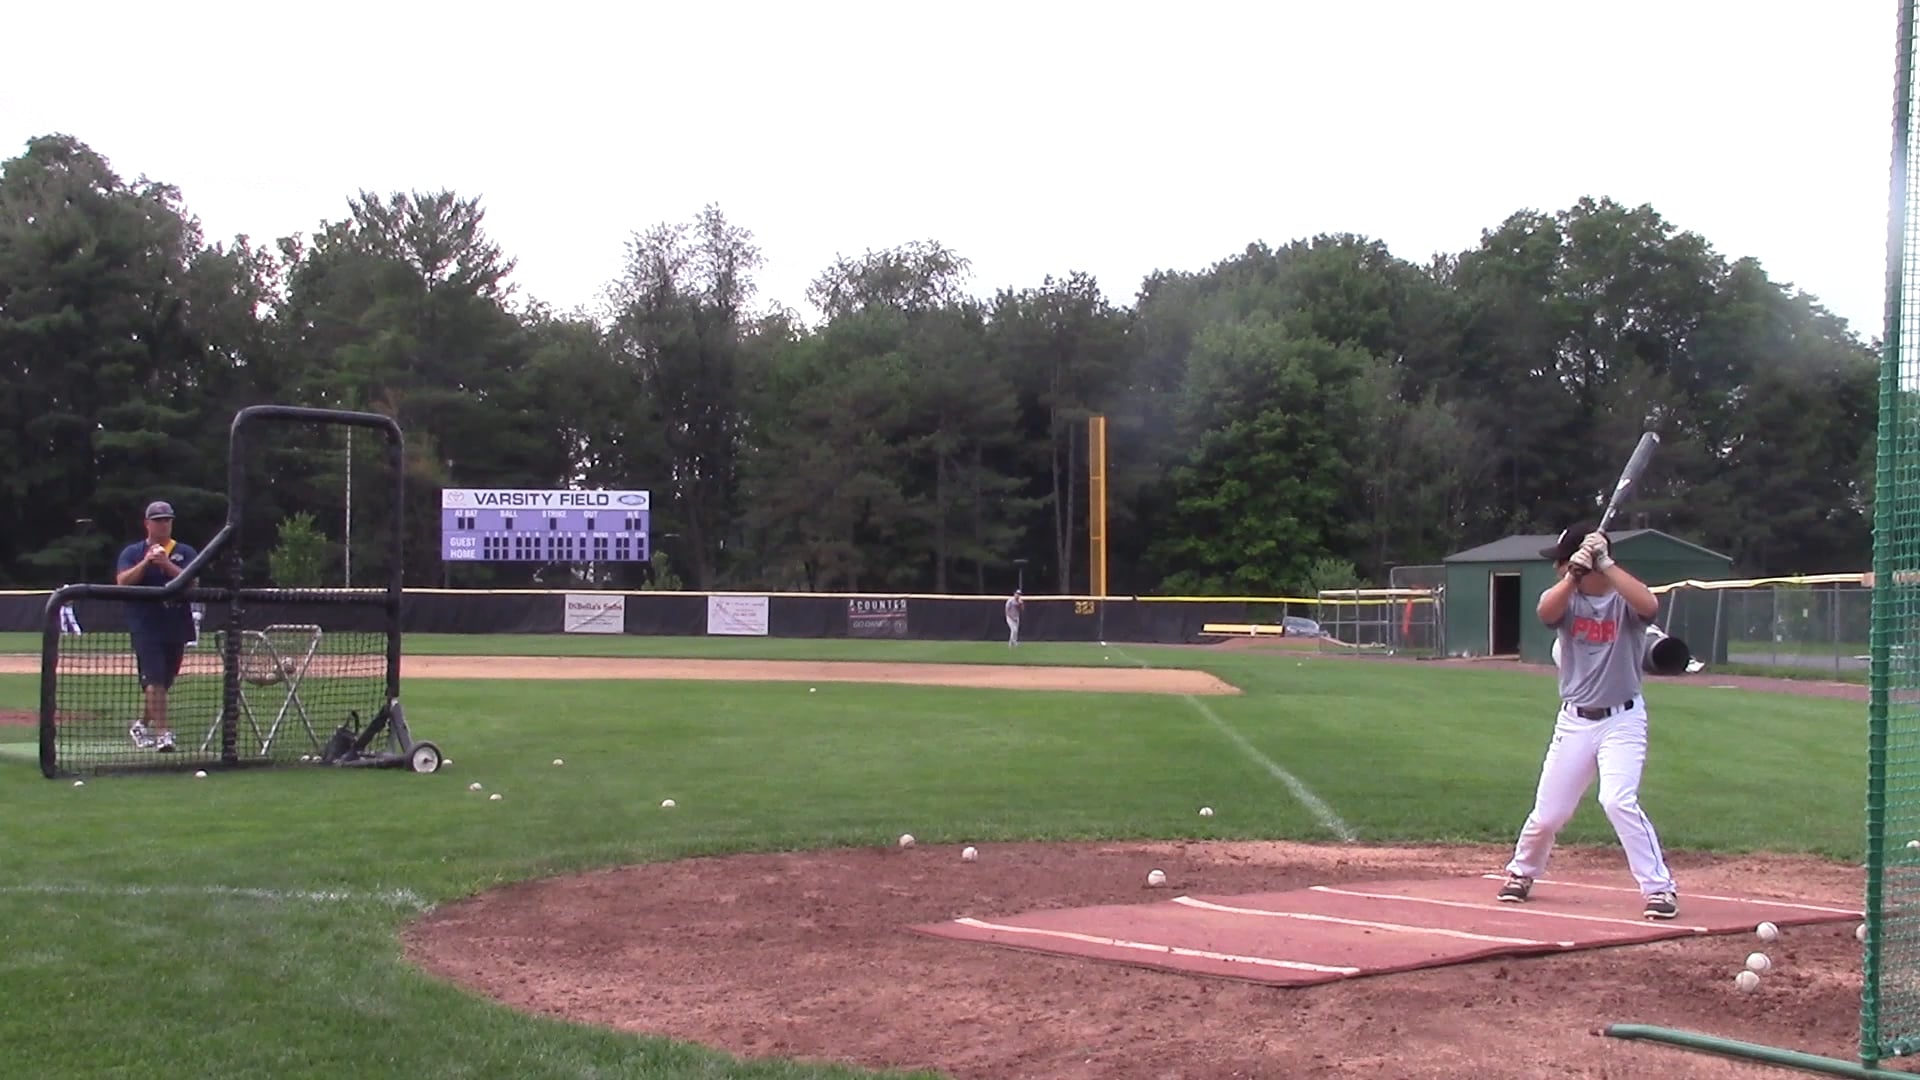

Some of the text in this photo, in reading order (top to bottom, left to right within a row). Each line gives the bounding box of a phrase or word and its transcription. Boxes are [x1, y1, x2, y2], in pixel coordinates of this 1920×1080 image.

[474, 492, 609, 506] VARSITY FIELD
[455, 509, 478, 518] AT BAT
[500, 510, 518, 518] BALL
[542, 510, 567, 519] STRIKE
[583, 510, 598, 519] OUT
[450, 537, 476, 547] GUEST
[450, 549, 476, 559] HOME
